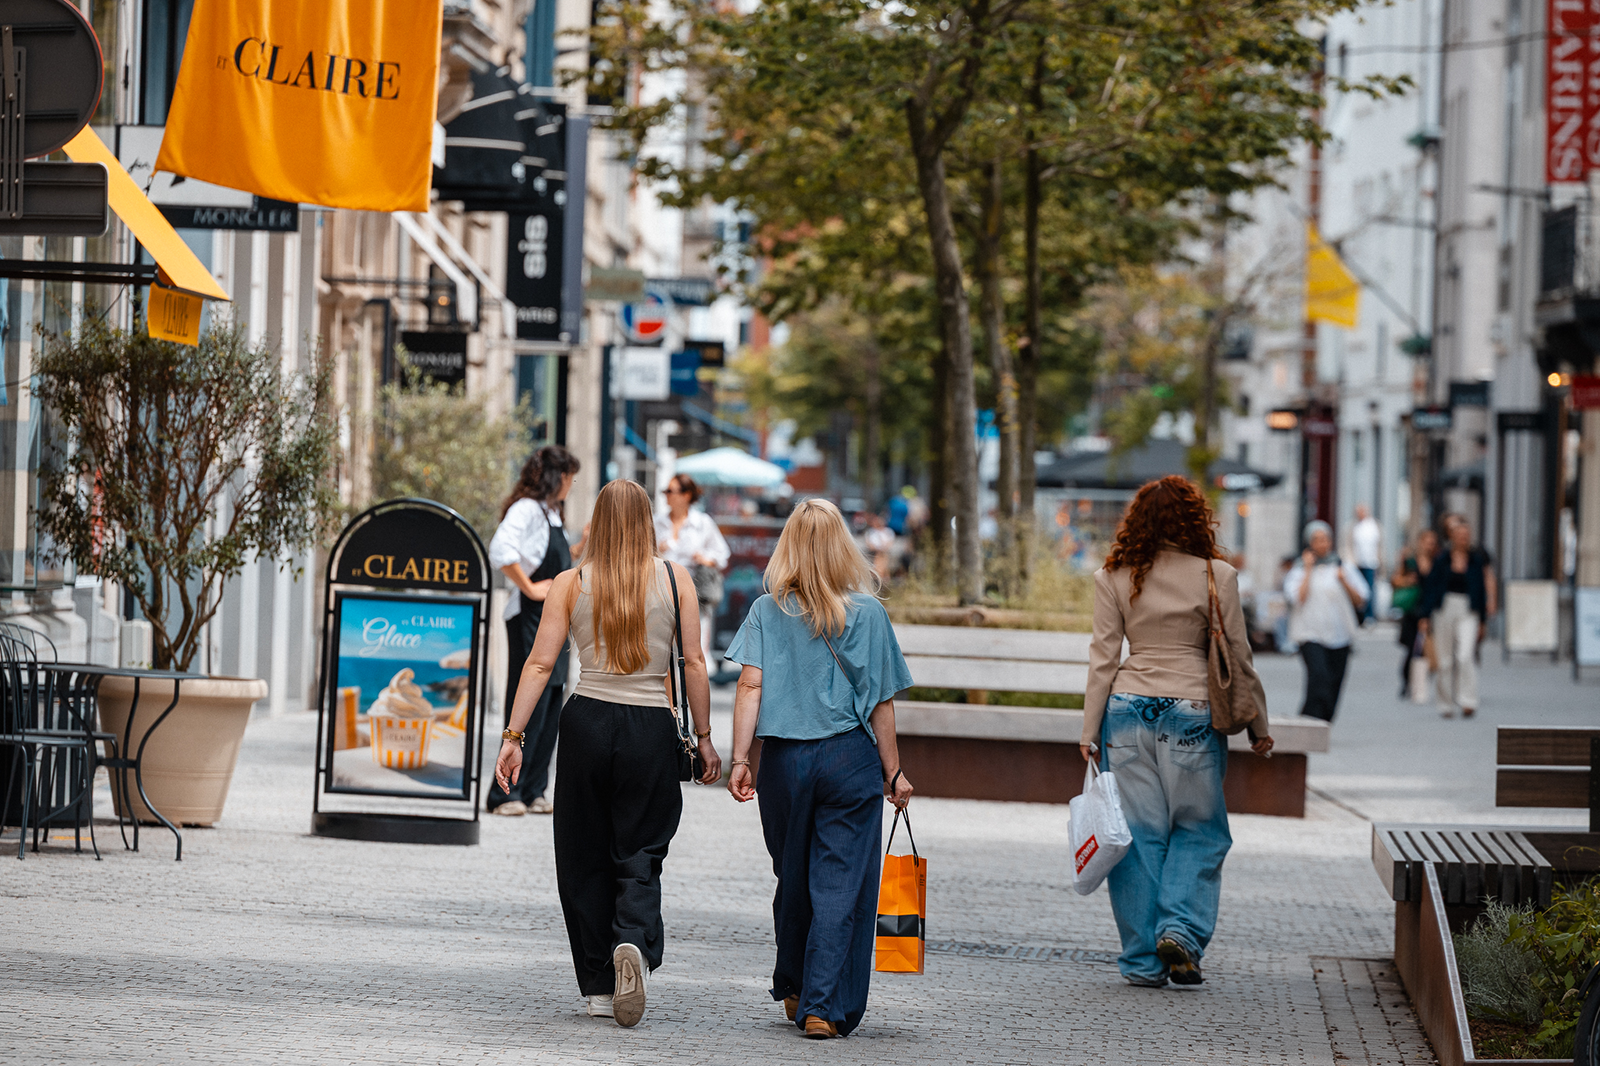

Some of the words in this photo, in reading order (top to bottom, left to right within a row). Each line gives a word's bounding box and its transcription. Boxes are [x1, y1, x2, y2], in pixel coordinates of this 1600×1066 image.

[233, 36, 401, 101] CLAIRE
[192, 208, 293, 228] MONCLER
[363, 554, 469, 584] CLAIRE
[411, 615, 456, 629] CLAIRE
[359, 617, 422, 658] Glace
[1157, 732, 1170, 744] JE
